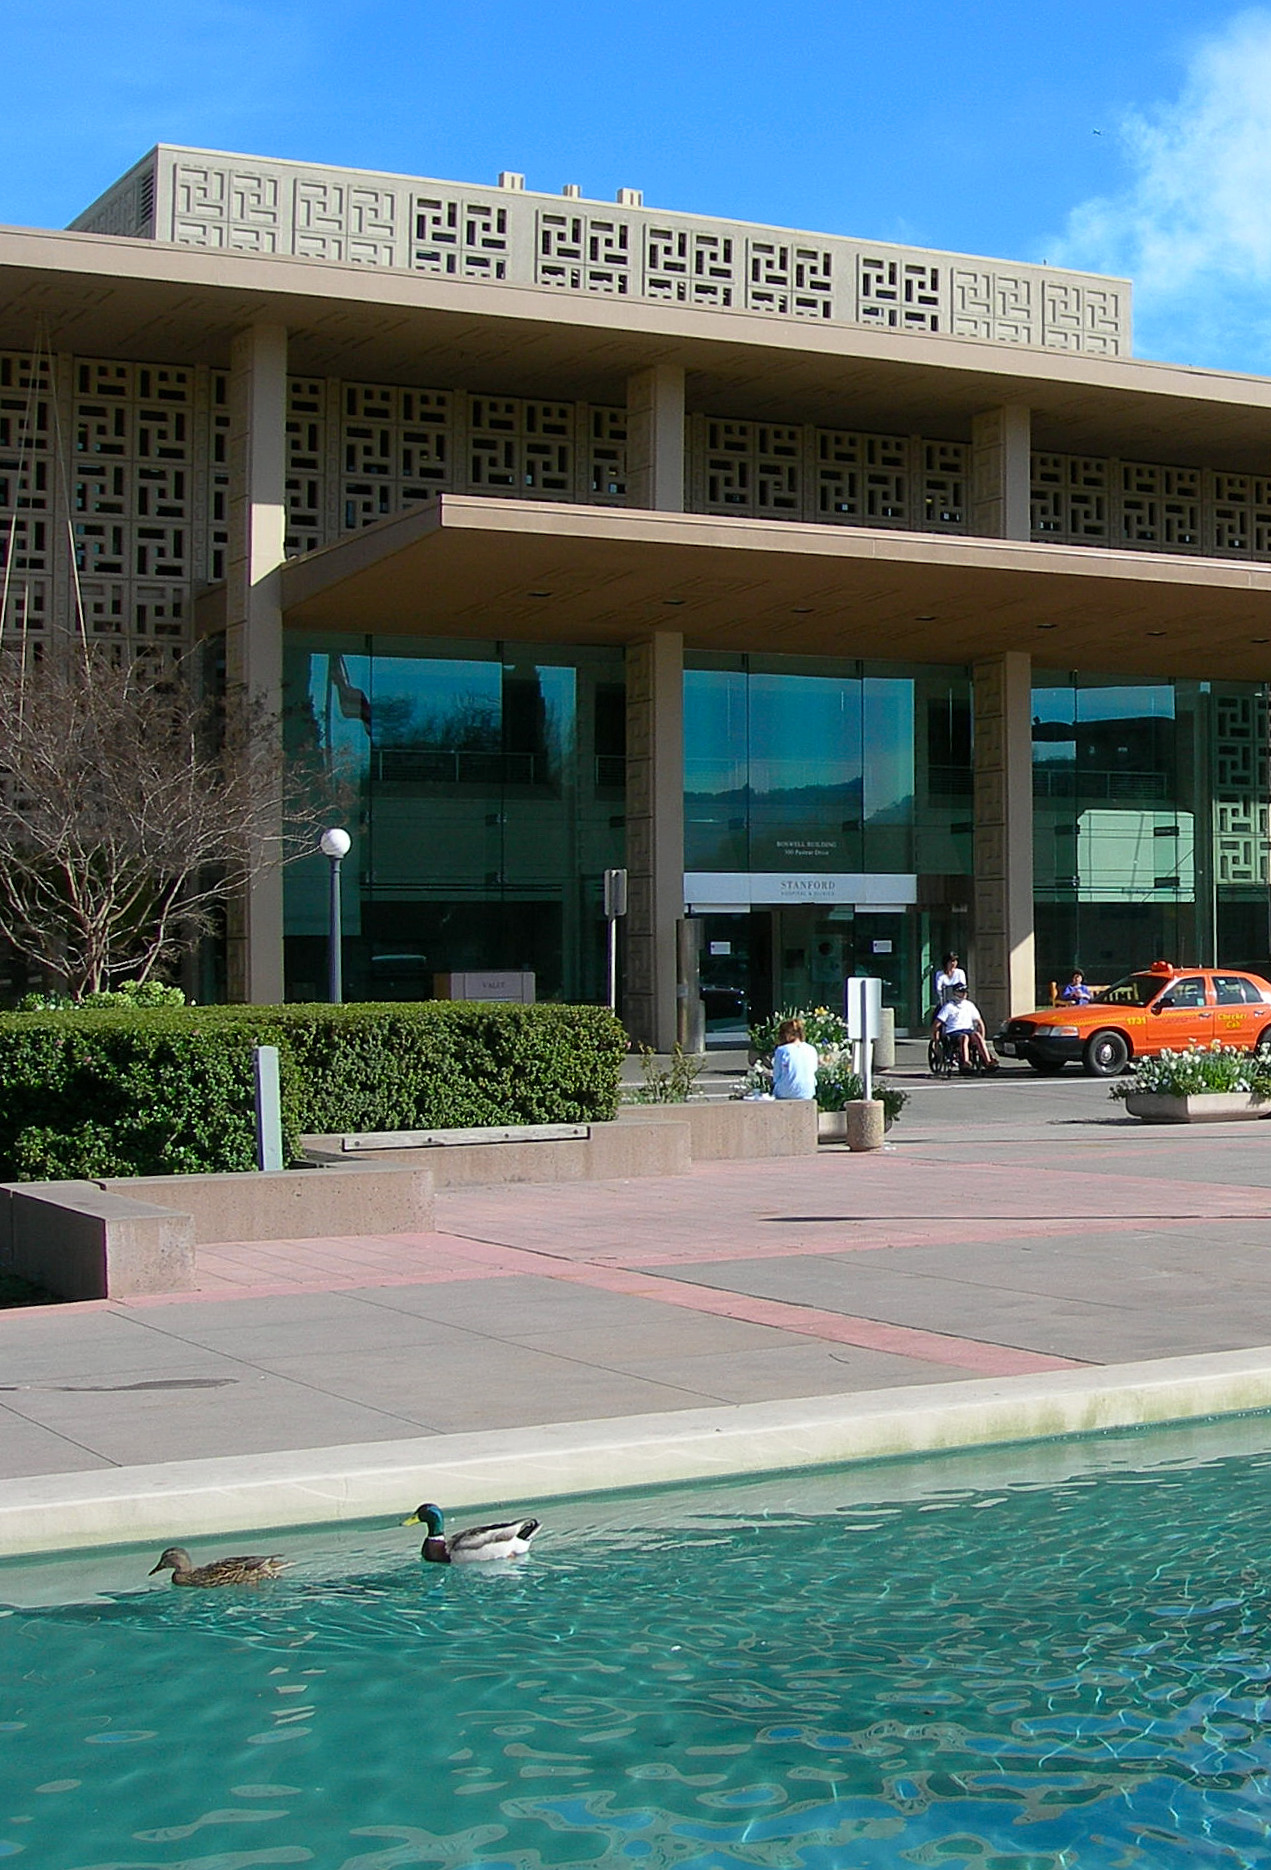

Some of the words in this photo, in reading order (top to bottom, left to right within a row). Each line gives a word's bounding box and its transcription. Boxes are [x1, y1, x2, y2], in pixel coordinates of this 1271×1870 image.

[780, 880, 836, 890] STANFORD
[1126, 1016, 1146, 1026] 1731
[1226, 1020, 1241, 1029] Cab
